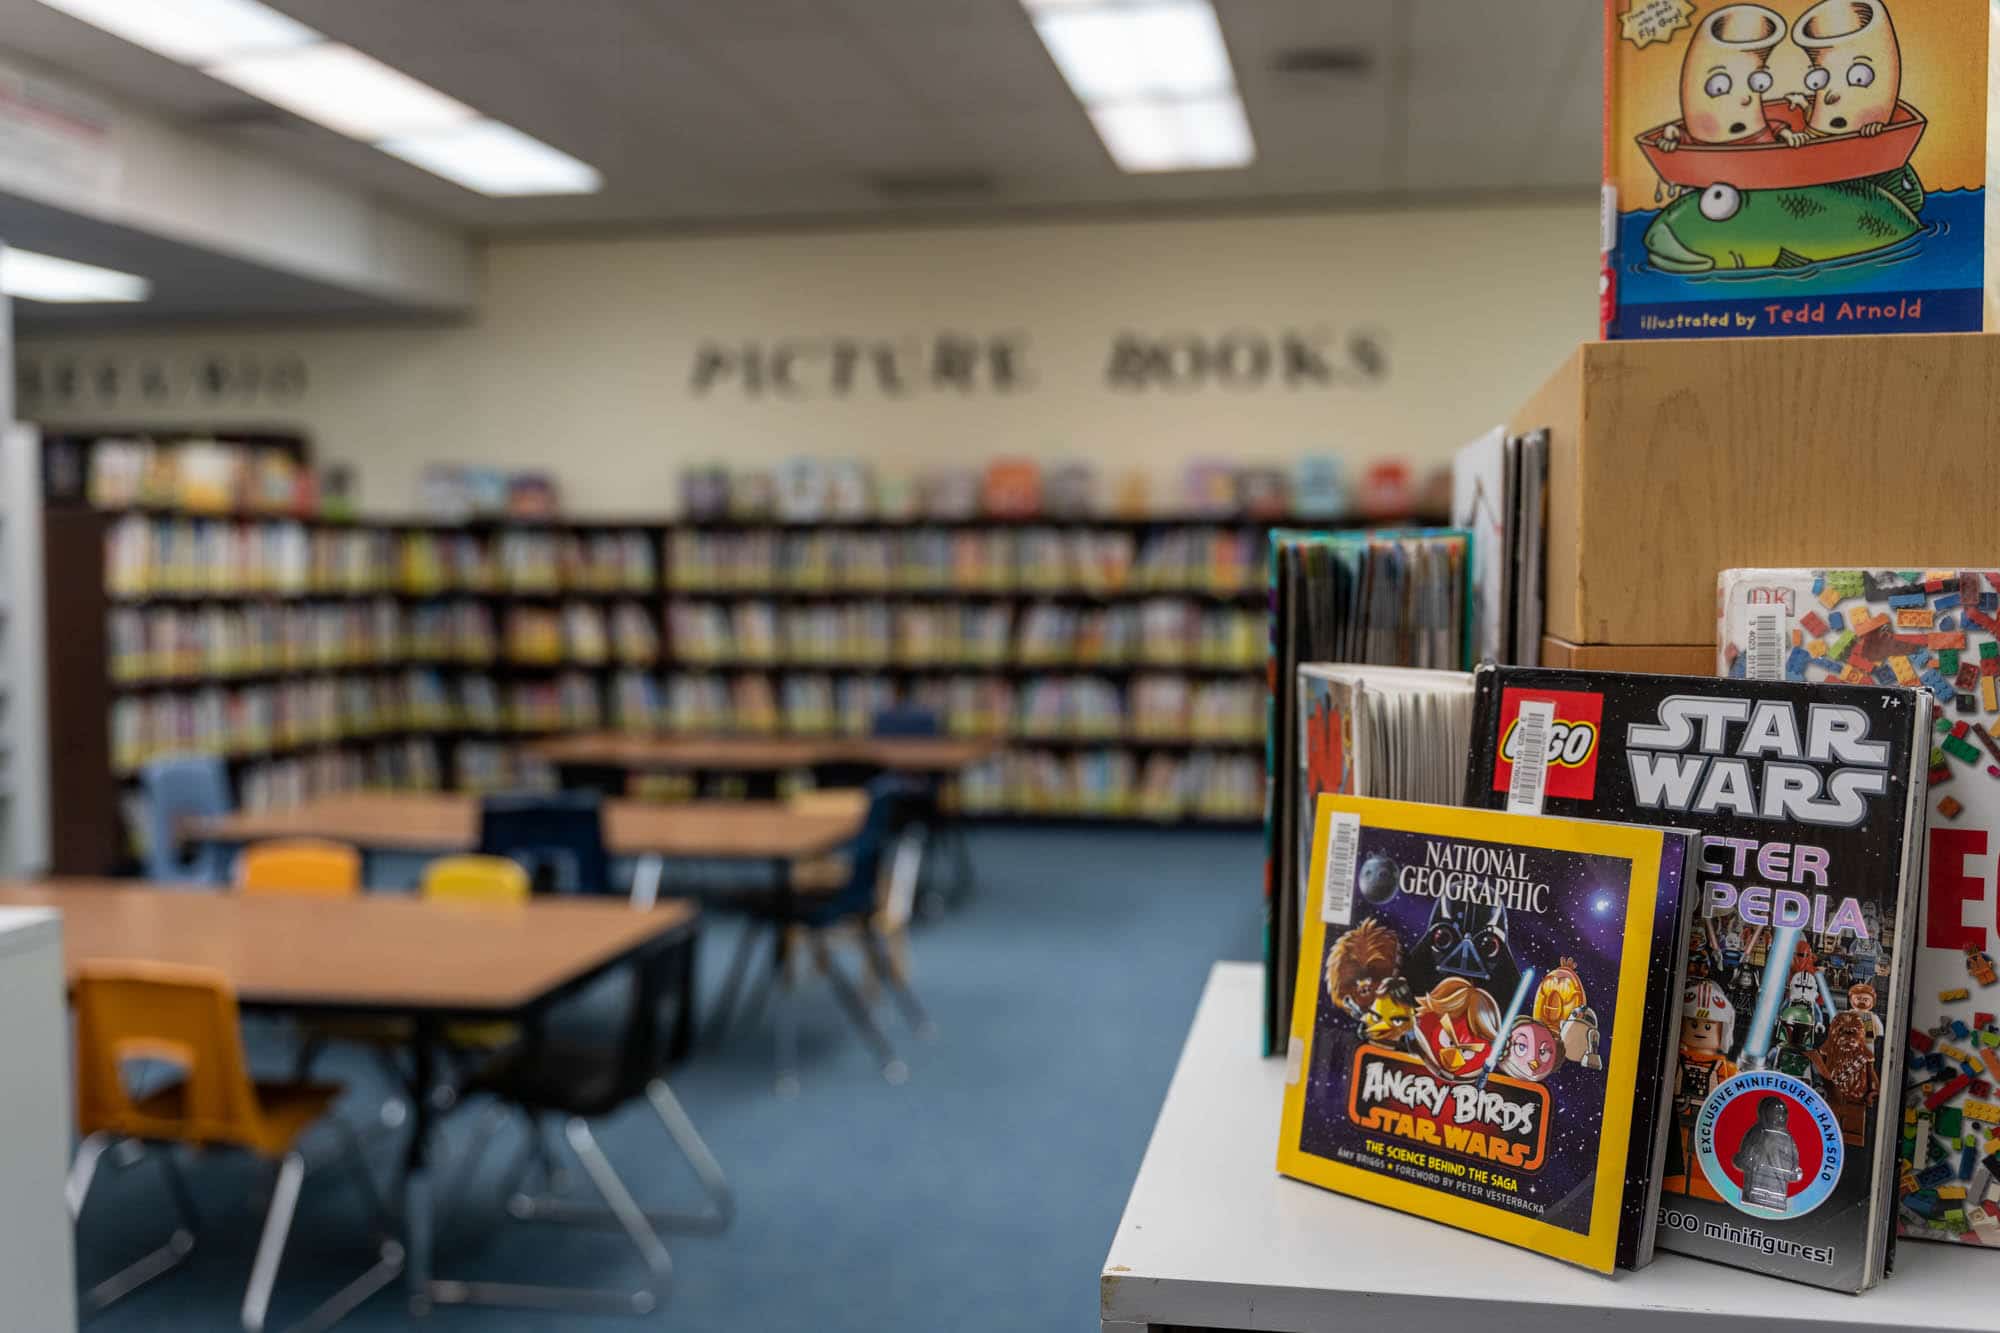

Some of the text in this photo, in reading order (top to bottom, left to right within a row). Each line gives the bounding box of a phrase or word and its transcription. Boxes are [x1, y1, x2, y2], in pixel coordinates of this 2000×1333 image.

[1638, 26, 1656, 40] Fly
[1640, 298, 1922, 330] illustrated by Tedd Arnold
[690, 327, 1391, 397] PICTURE BOOKS
[1881, 696, 1900, 709] 7+
[1501, 720, 1596, 767] LGO
[1626, 694, 1892, 769] STAR
[1626, 749, 1890, 829] WARS
[1424, 840, 1530, 881] NATIONAL
[1701, 835, 1830, 887] CTER
[1399, 865, 1550, 914] GEOGRAPHIC
[1702, 880, 1870, 939] PEDIA
[1362, 1061, 1537, 1136] ANGRY BIRDS
[1358, 1106, 1531, 1168] STAR WARS
[1701, 1076, 1838, 1181] EXCLUSIVE MINIFIGURE HAN SOLO
[1336, 1146, 1546, 1215] AMY BRIGGS FOREWORD BY PETER VESTERBACKA
[1365, 1139, 1519, 1193] THE SCIENCE BEHIND THE SAGA
[1703, 1221, 1836, 1266] minifigures!
